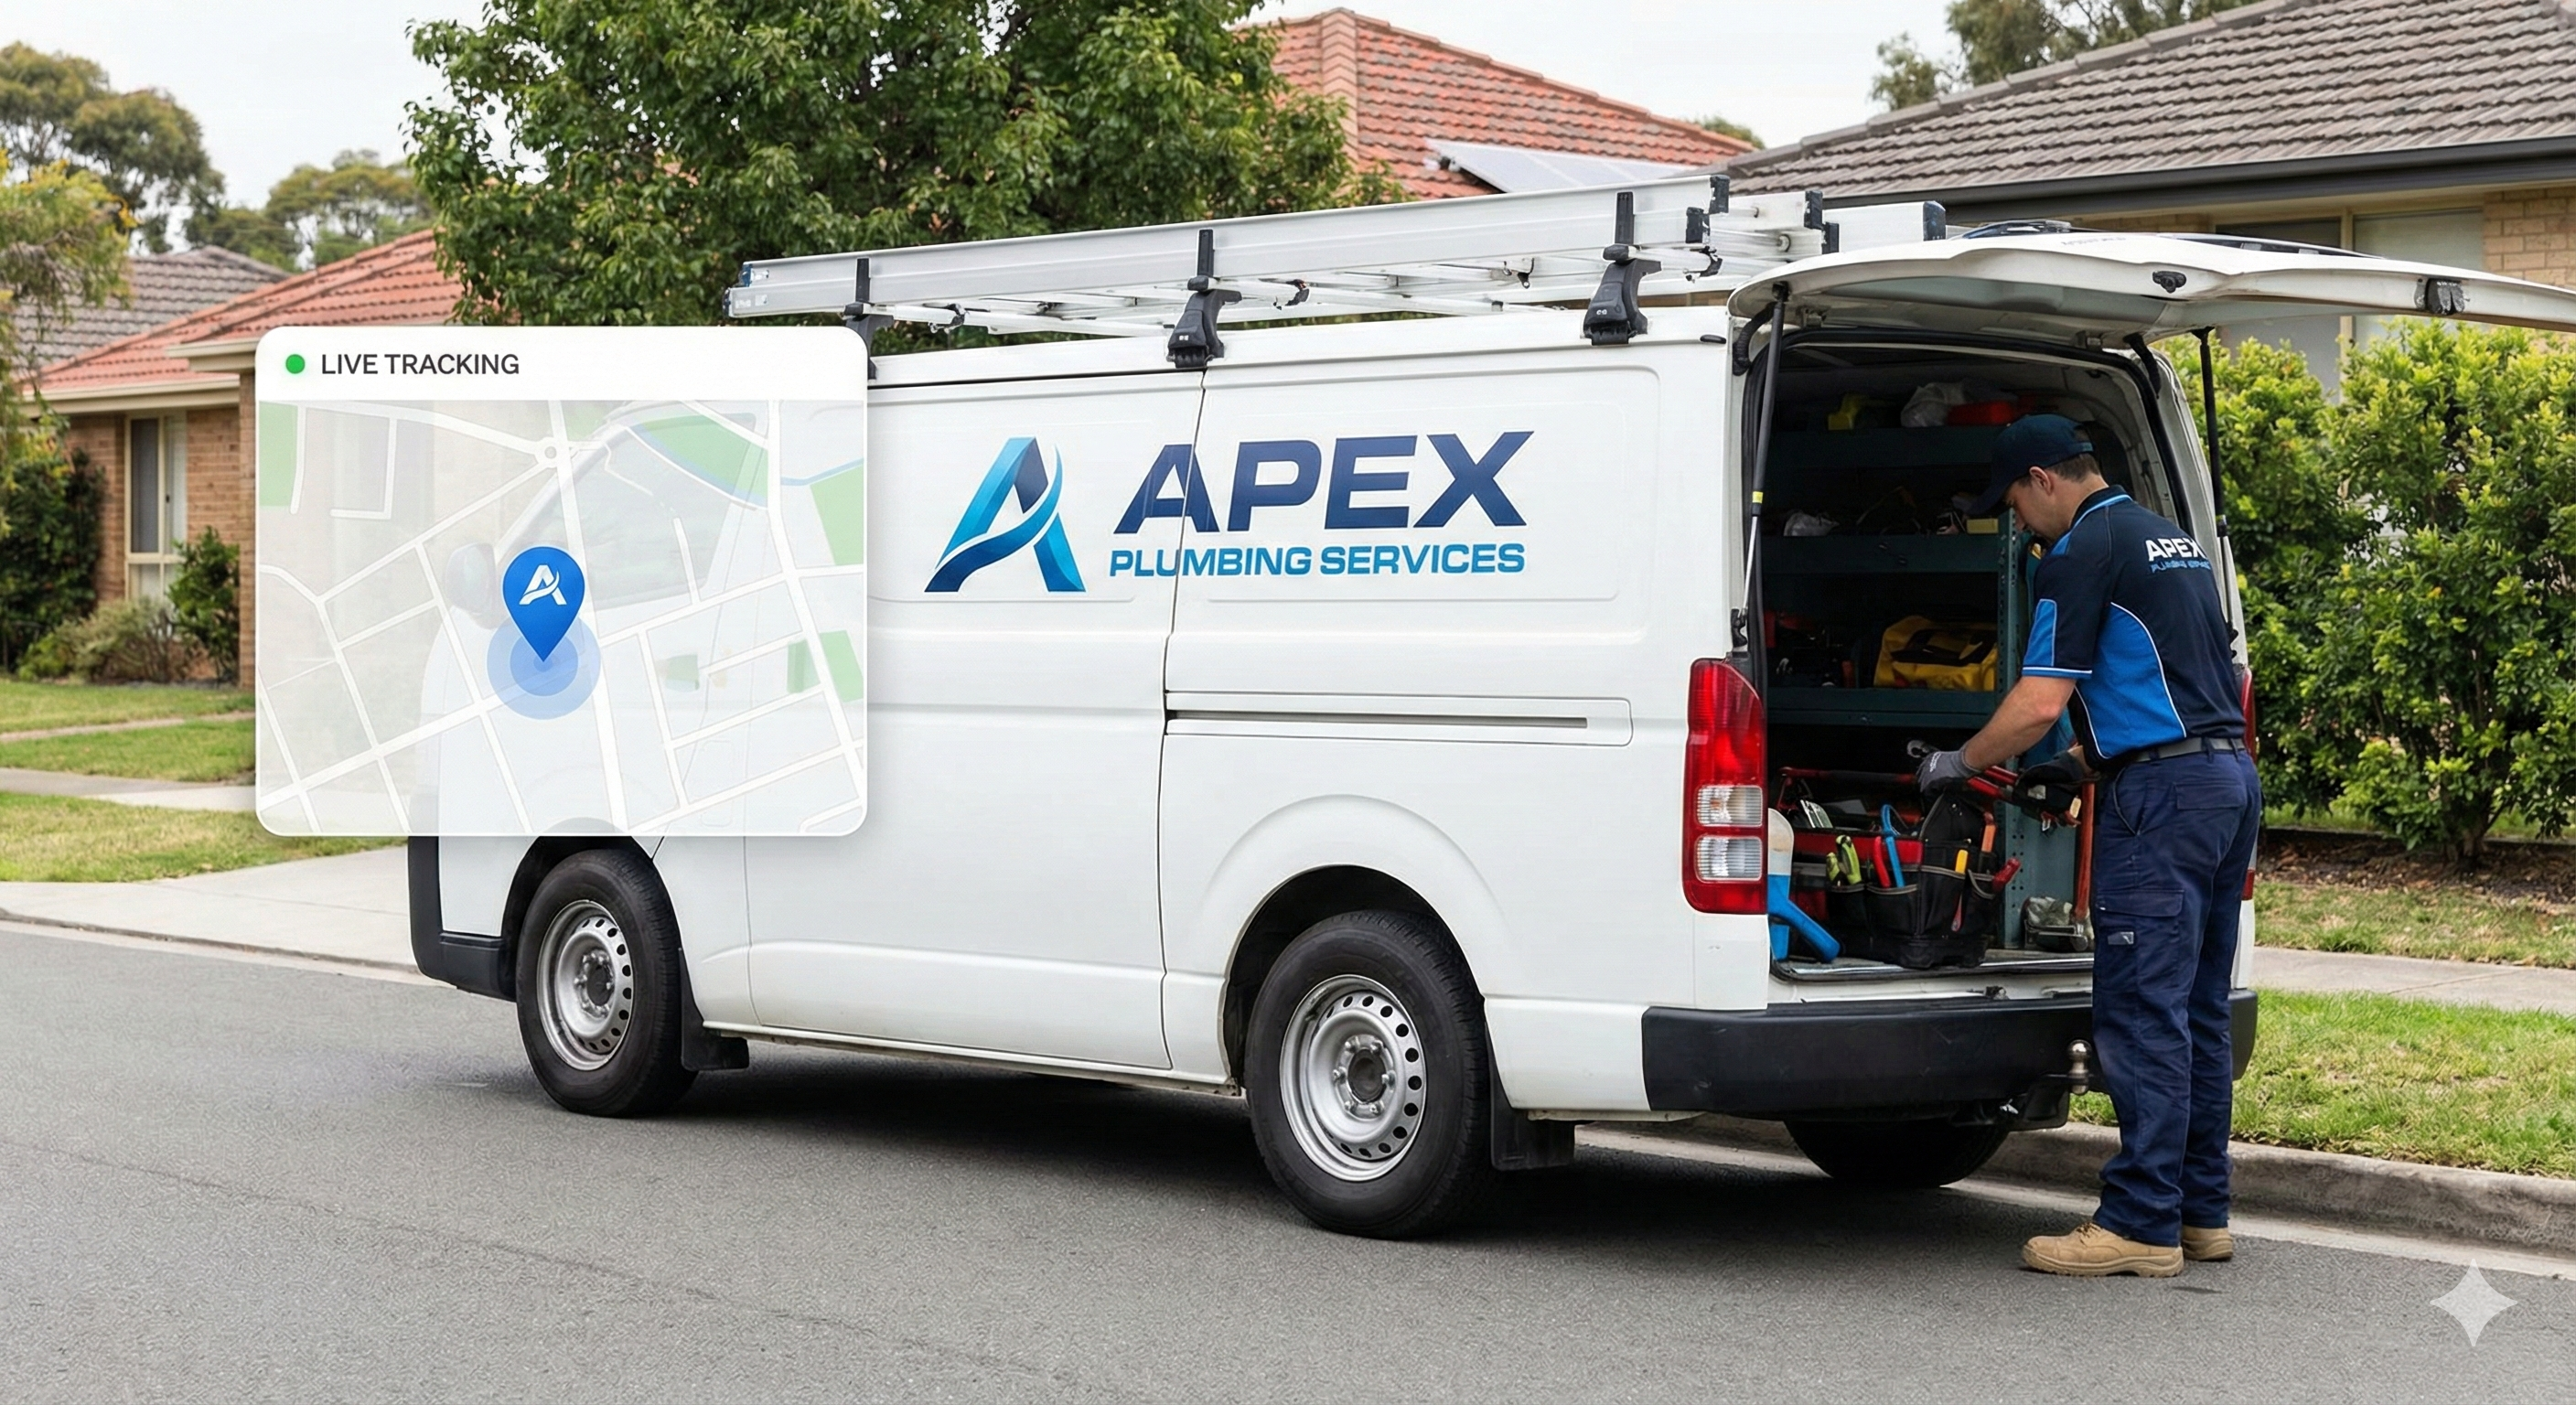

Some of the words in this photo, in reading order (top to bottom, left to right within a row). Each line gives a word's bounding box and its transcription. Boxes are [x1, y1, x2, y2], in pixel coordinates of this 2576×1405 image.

[1113, 430, 1535, 534] APEX
[1110, 546, 1312, 577] PLUMBING
[1319, 542, 1526, 574] SERVICES
[2145, 537, 2207, 562] APEX
